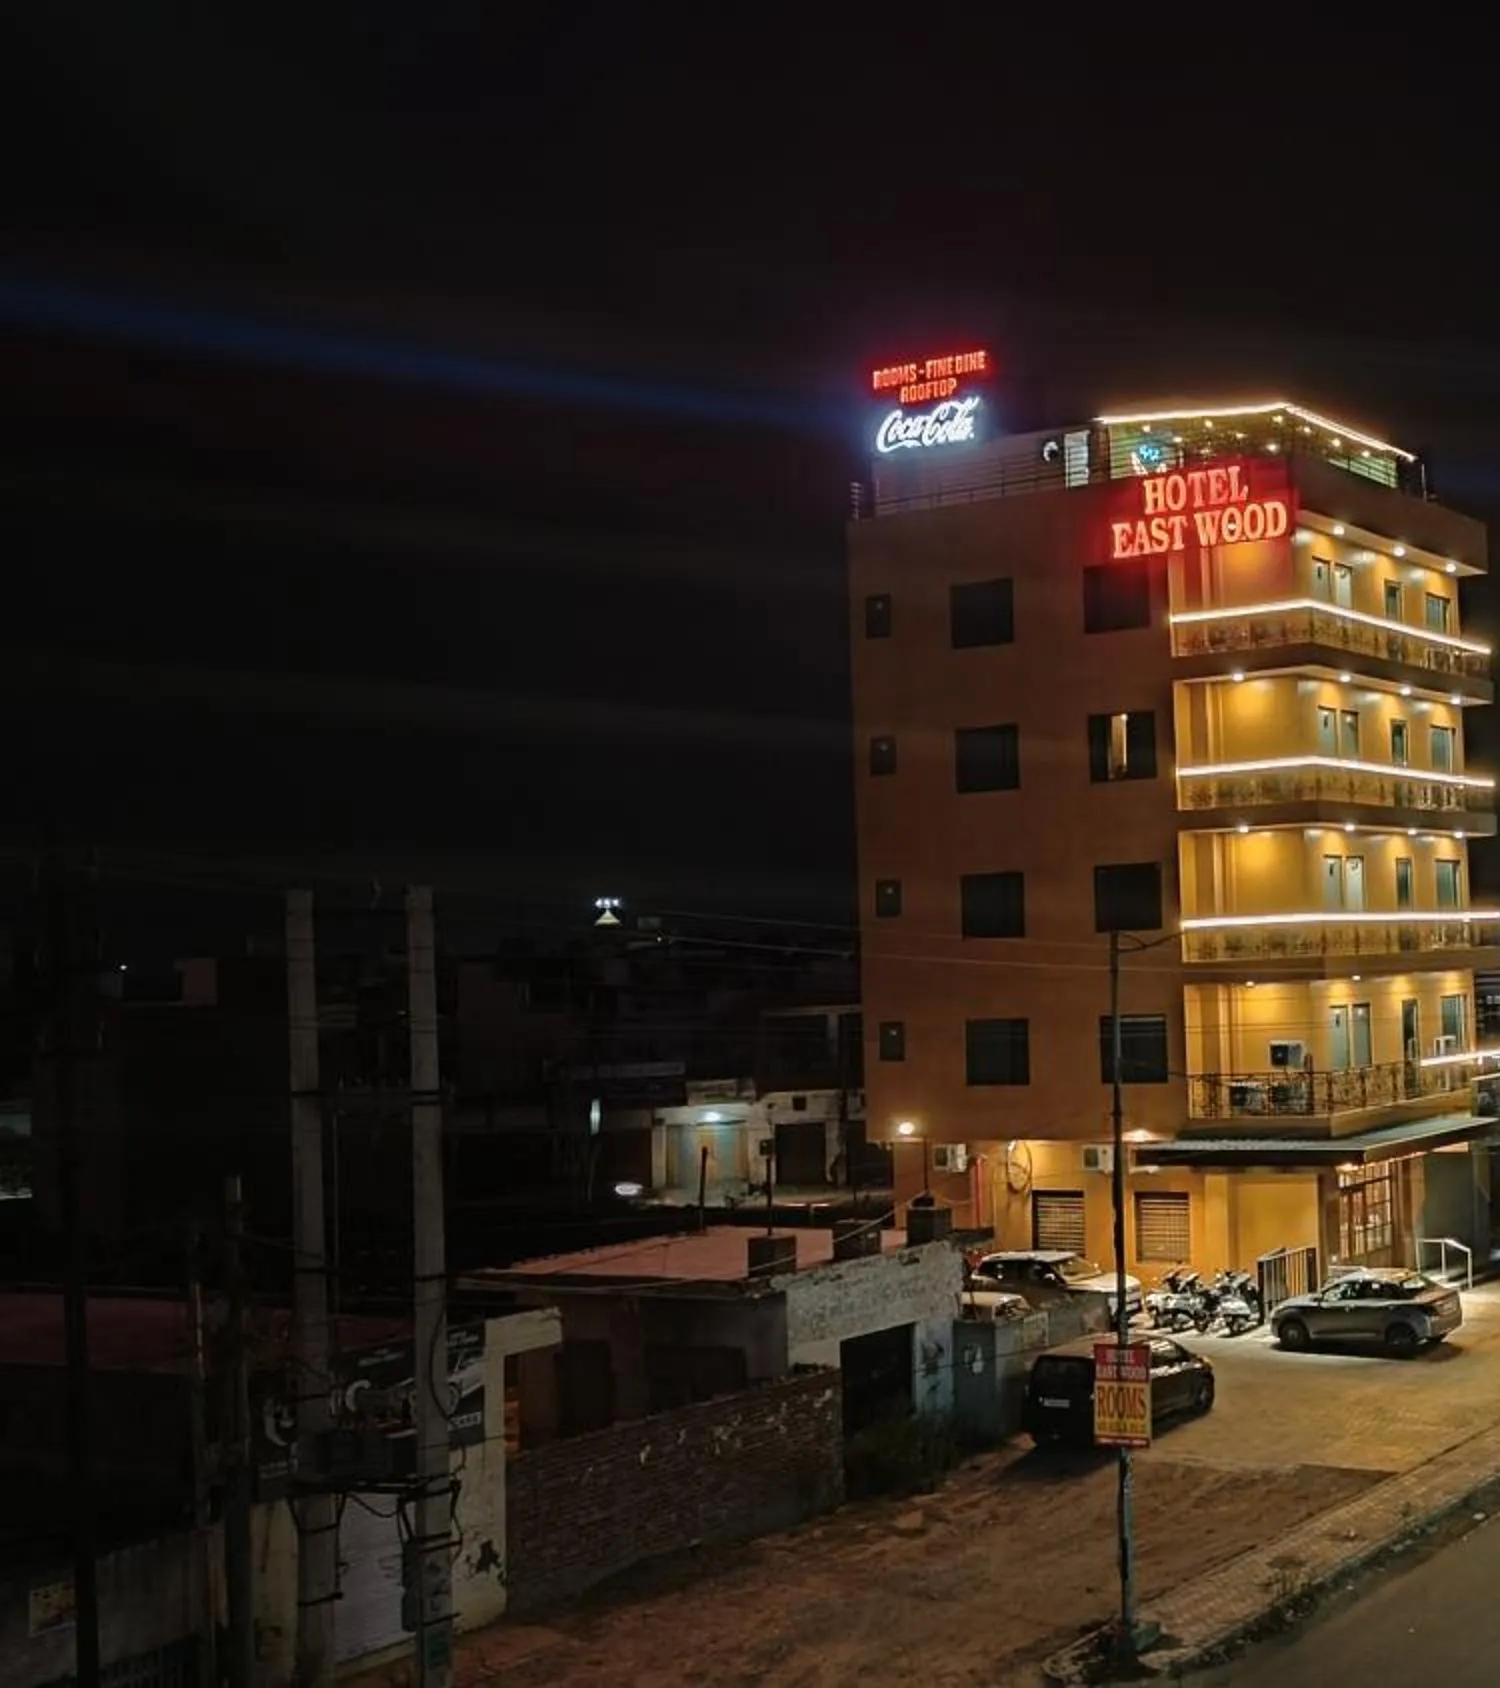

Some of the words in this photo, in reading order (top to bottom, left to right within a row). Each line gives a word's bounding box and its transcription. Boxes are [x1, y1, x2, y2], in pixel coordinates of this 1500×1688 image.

[873, 363, 917, 390] ROOMS
[925, 356, 954, 380] FINE
[955, 350, 986, 374] DINE
[900, 377, 958, 404] ROOFTOP
[1143, 465, 1249, 515] HOTEL
[1112, 515, 1188, 559] EAST
[1194, 501, 1287, 547] WOOD
[1097, 1384, 1148, 1420] ROOMS
